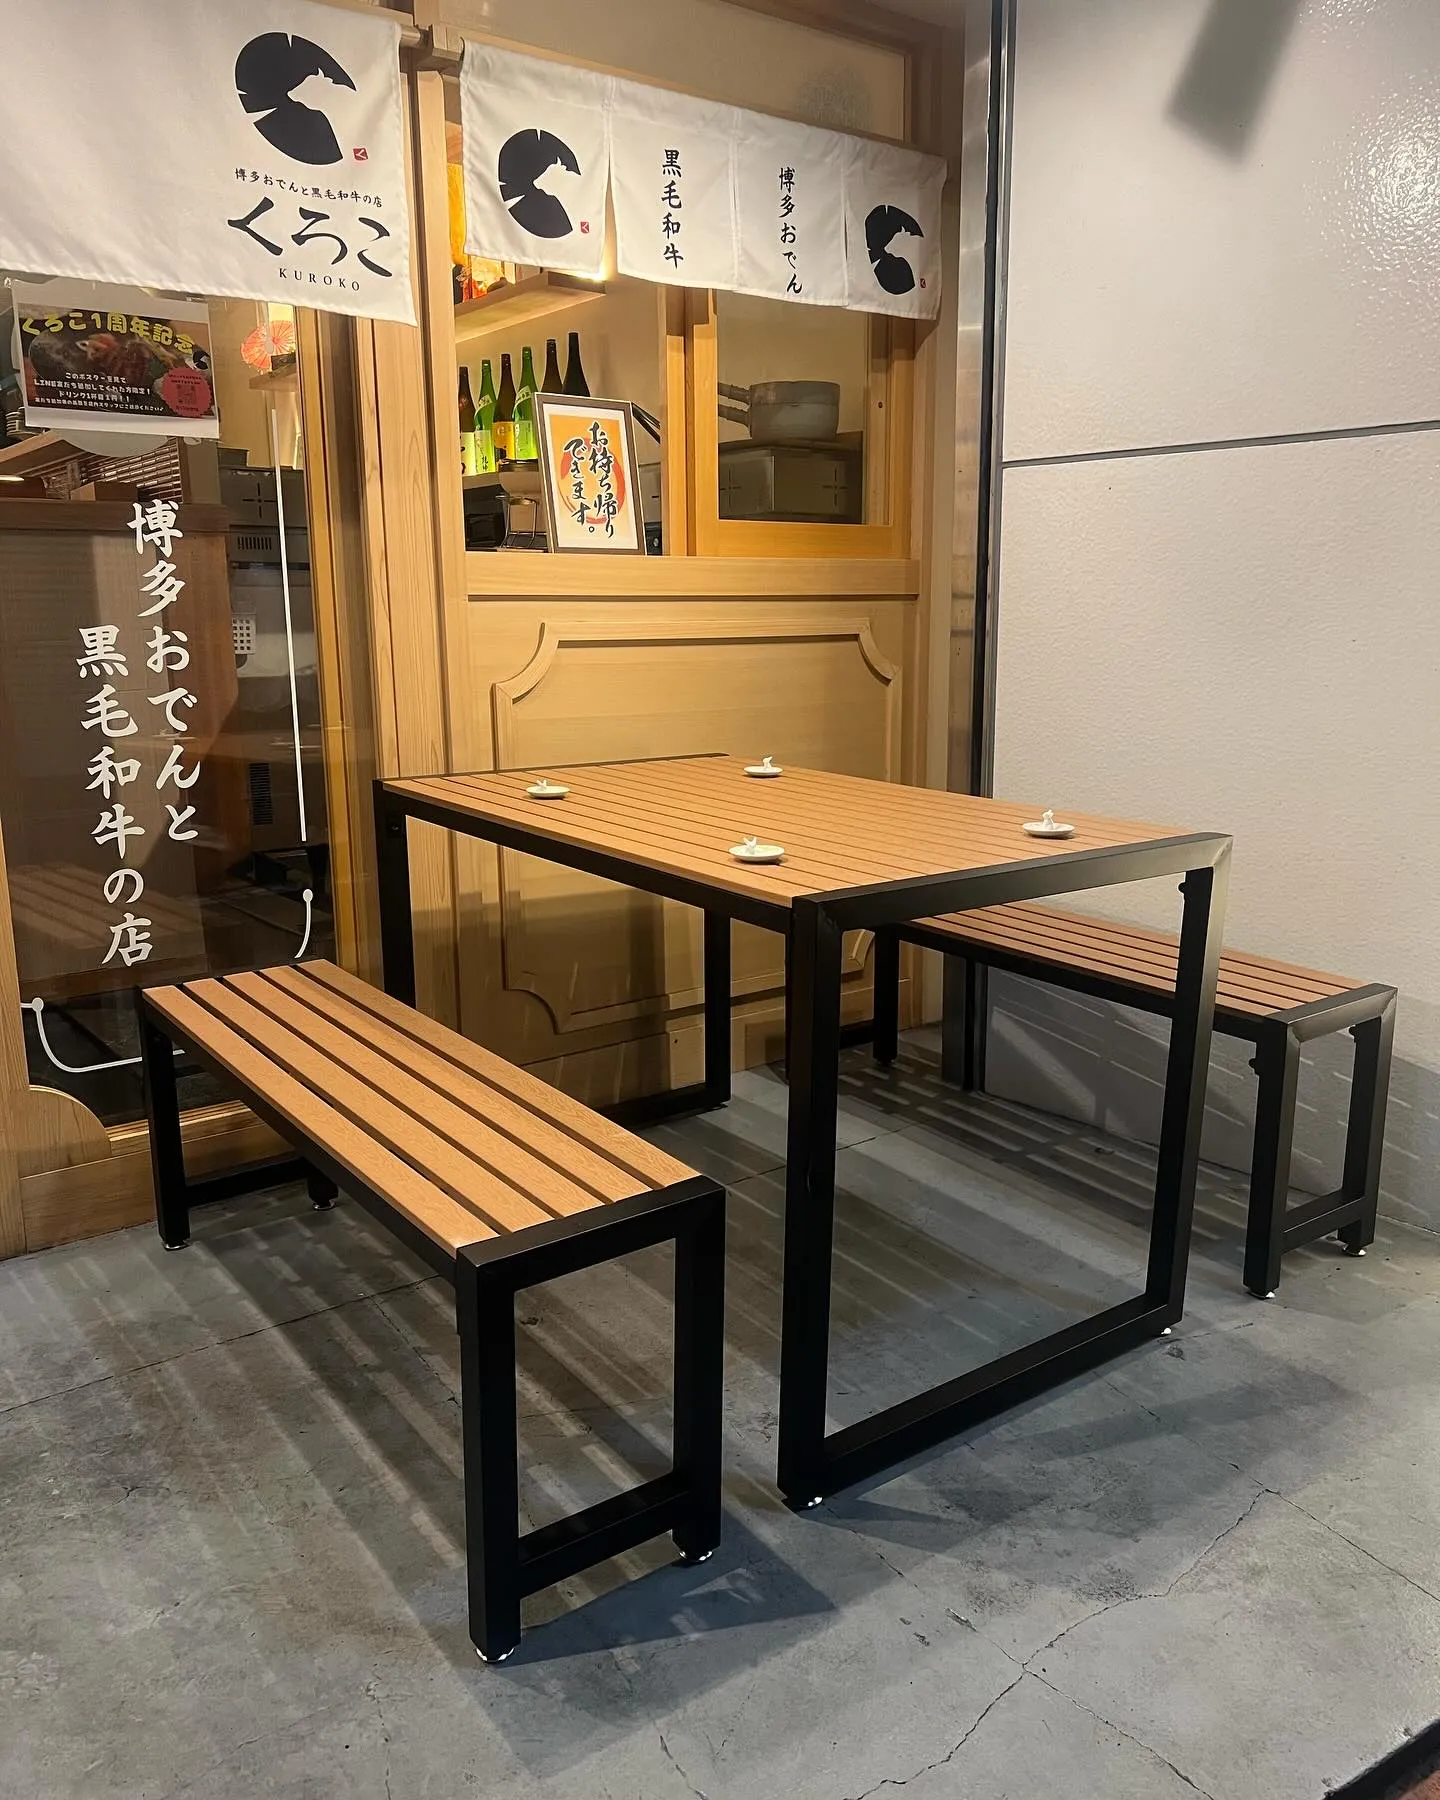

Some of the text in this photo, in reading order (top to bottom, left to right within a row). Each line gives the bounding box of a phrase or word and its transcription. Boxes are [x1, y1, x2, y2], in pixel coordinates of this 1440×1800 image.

[227, 196, 393, 278] くろこ
[234, 168, 383, 208] 博多おでんと黒毛和牛の店
[661, 149, 684, 270] 黒毛和牛
[778, 167, 803, 295] 博多おでん
[22, 311, 194, 354] くろこ1周年記念
[279, 268, 360, 291] KUROKO
[564, 436, 595, 534] できます。
[588, 421, 618, 538] お持ち帰り
[127, 499, 201, 842] 博多おでんと
[75, 625, 154, 967] 黒毛和牛の店
